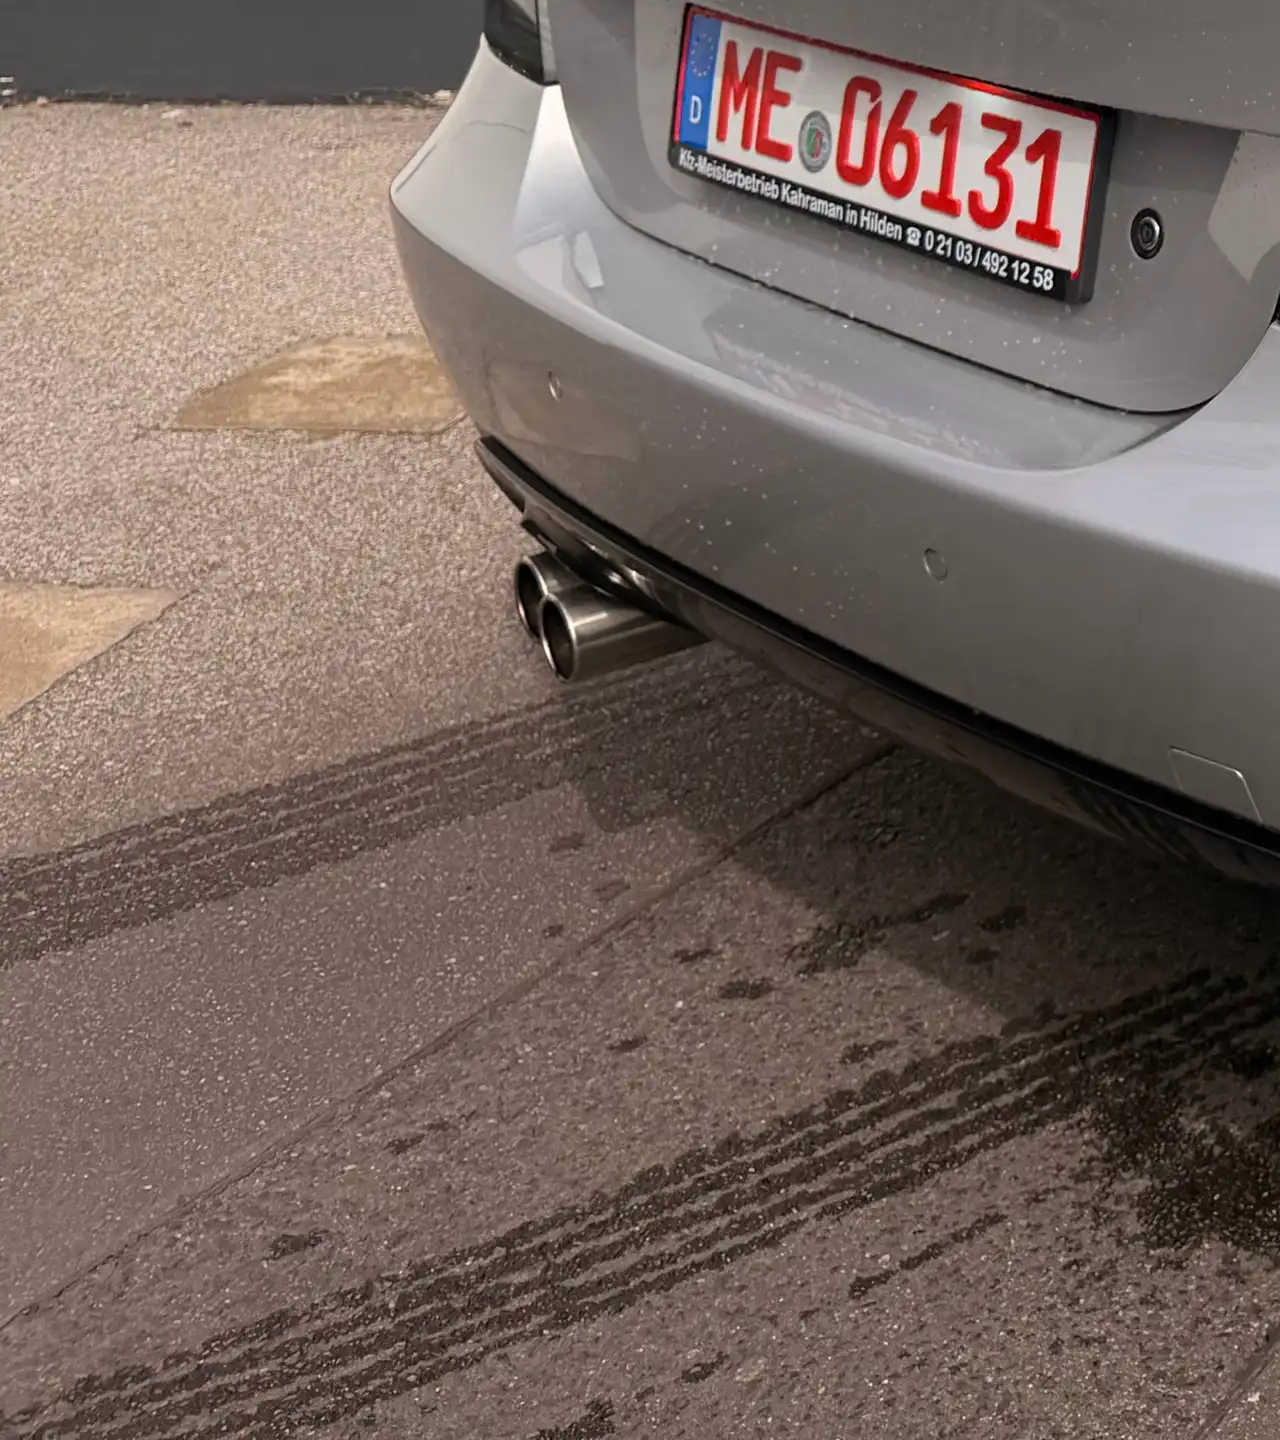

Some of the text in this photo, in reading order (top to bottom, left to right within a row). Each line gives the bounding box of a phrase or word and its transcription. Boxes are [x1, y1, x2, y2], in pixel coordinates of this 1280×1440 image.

[689, 95, 702, 124] D
[716, 40, 1062, 249] ME 06131
[678, 147, 780, 200] Kfz-Meisterbetrieb
[780, 182, 844, 221] Kahraman
[845, 203, 858, 226] in
[860, 208, 902, 241] Hilden
[924, 230, 934, 251] 0
[936, 234, 952, 258] 21
[1011, 260, 1030, 284] 12
[1033, 266, 1054, 291] 58
